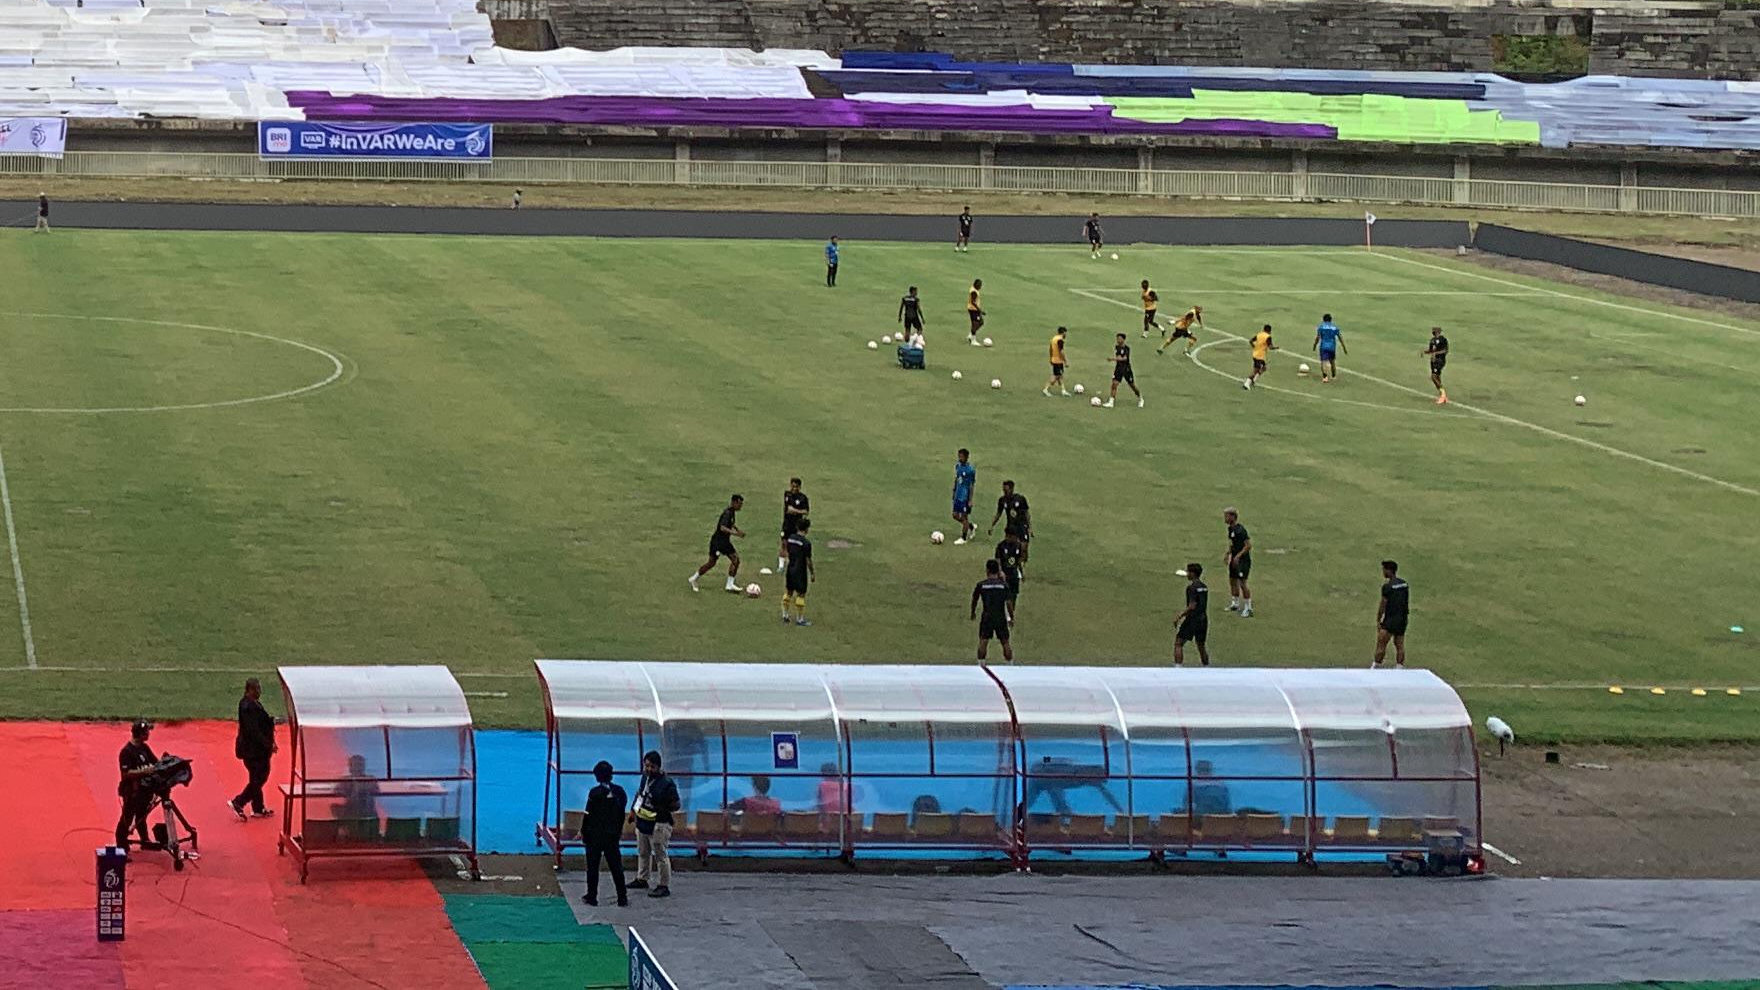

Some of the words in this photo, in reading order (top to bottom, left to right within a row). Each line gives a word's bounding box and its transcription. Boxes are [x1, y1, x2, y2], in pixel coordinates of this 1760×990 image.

[270, 133, 287, 141] BRI
[304, 135, 322, 143] VAR
[329, 133, 456, 150] #InVARWeAre
